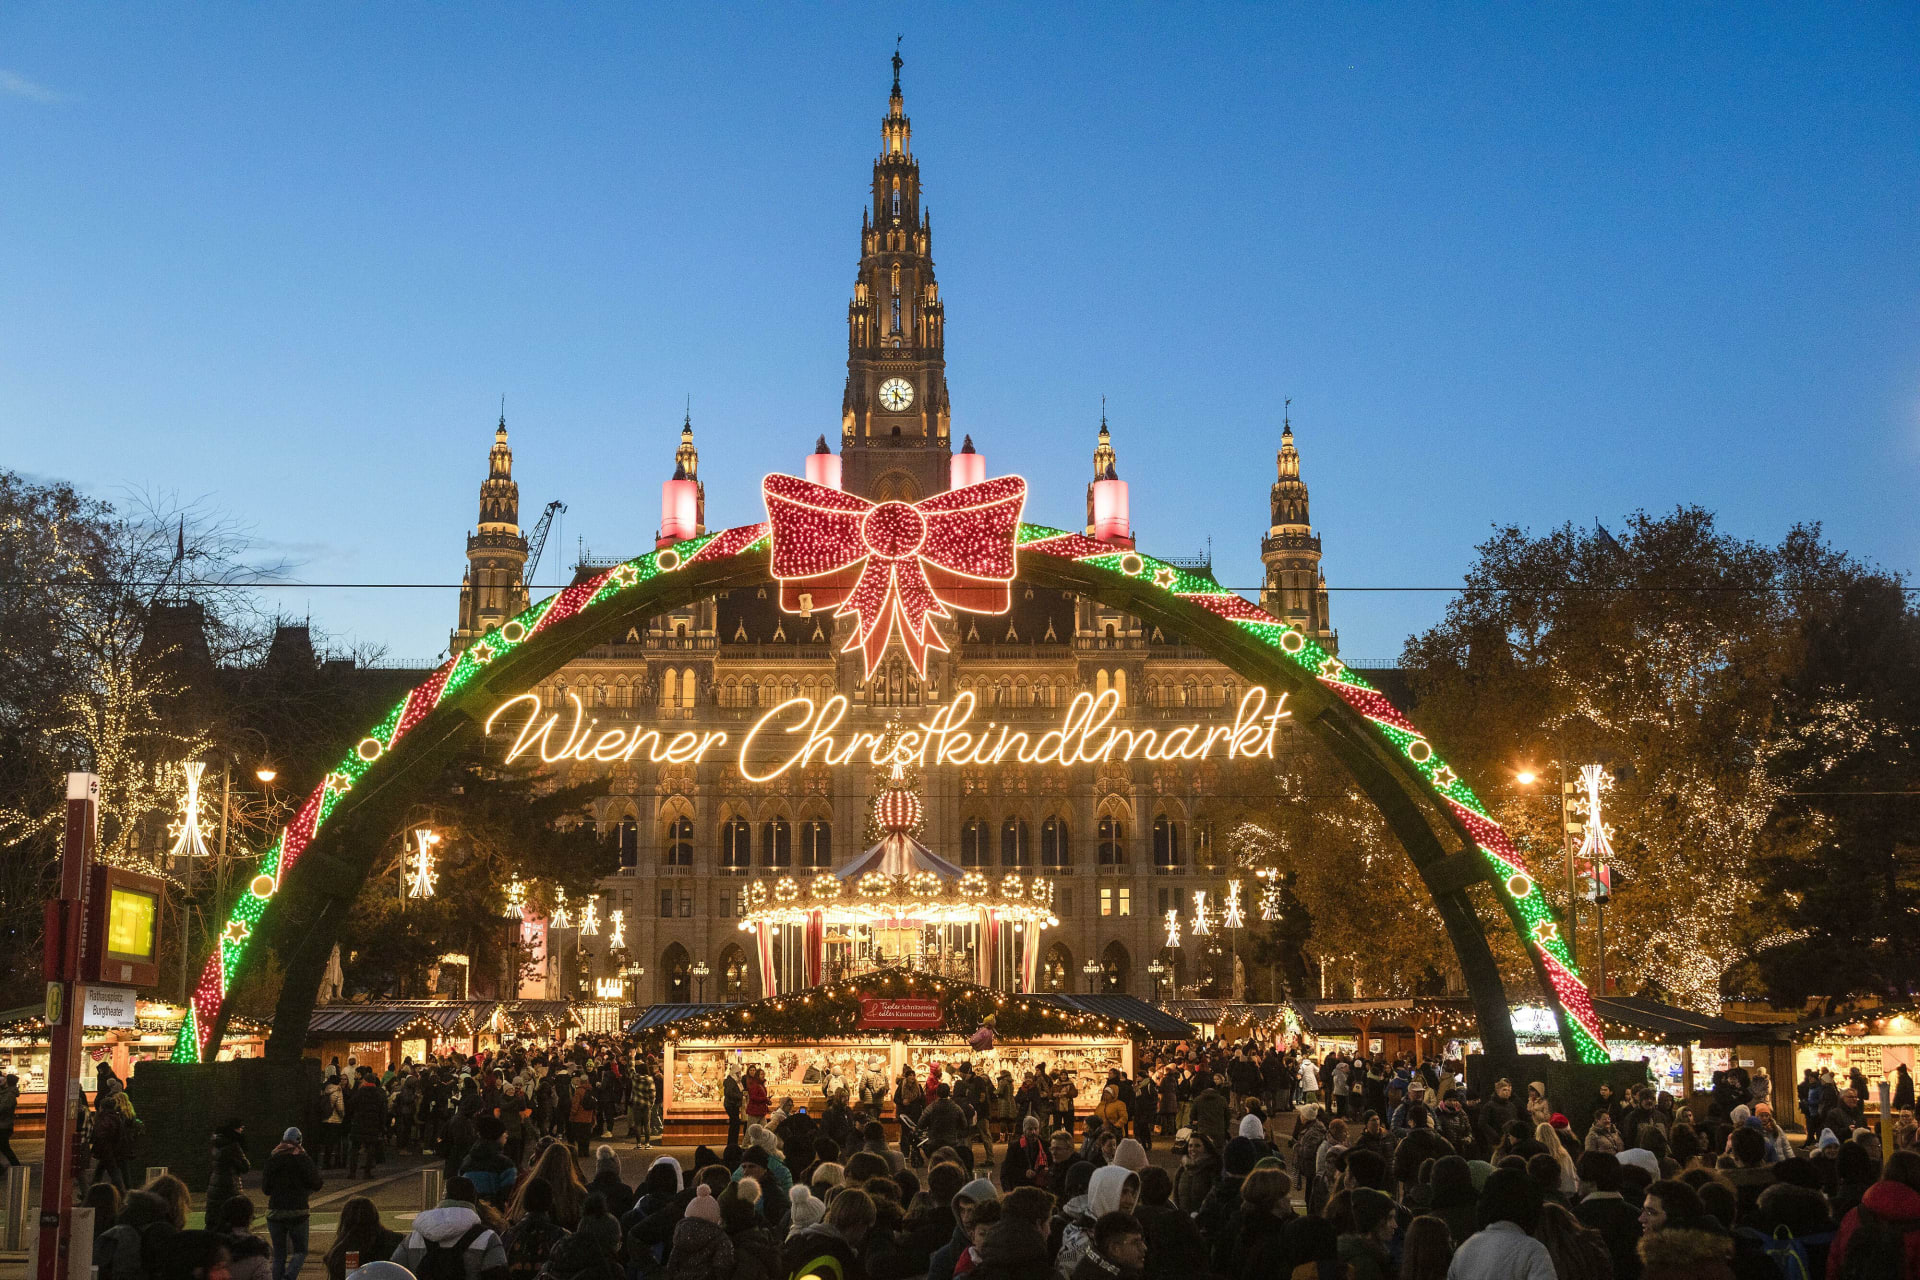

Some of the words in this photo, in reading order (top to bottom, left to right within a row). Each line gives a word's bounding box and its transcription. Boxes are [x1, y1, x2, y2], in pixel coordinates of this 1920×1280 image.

[485, 693, 728, 764] Wiener
[740, 686, 1292, 783] Christkindlmarkt
[92, 1004, 124, 1019] Burgtheater
